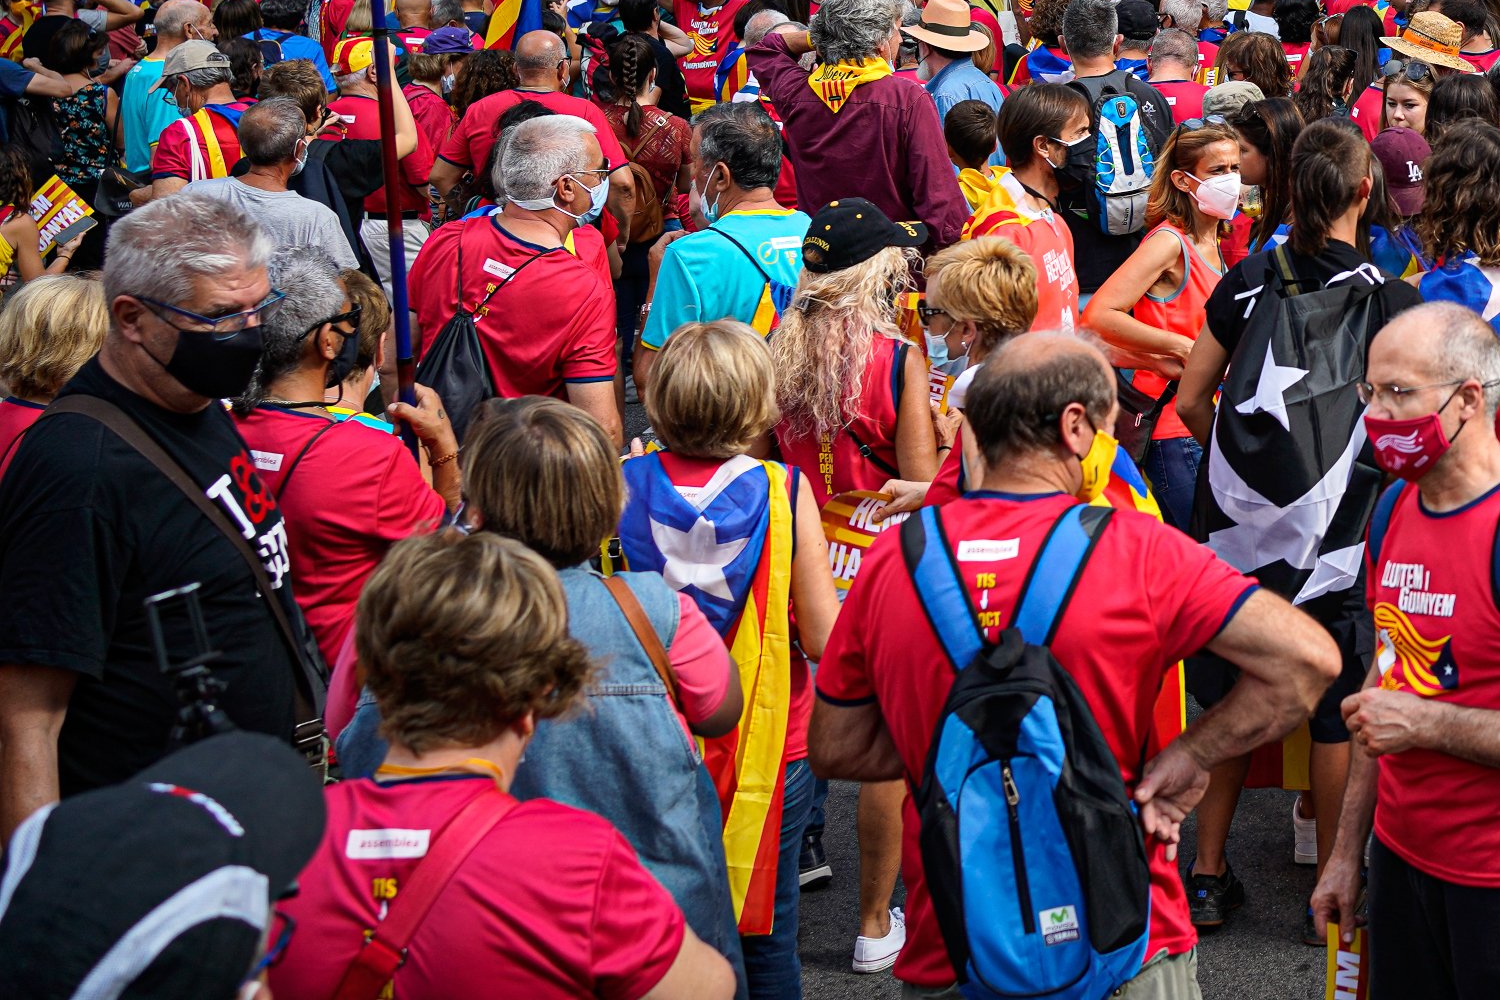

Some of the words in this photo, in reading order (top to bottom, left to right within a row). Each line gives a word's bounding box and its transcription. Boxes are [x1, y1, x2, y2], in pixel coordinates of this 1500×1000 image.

[1405, 160, 1424, 183] LA
[821, 443, 832, 453] DE
[819, 453, 834, 464] PEN
[825, 474, 832, 485] CI
[826, 485, 833, 496] A
[1398, 586, 1457, 618] GUANYEM
[360, 837, 420, 849] assemblea
